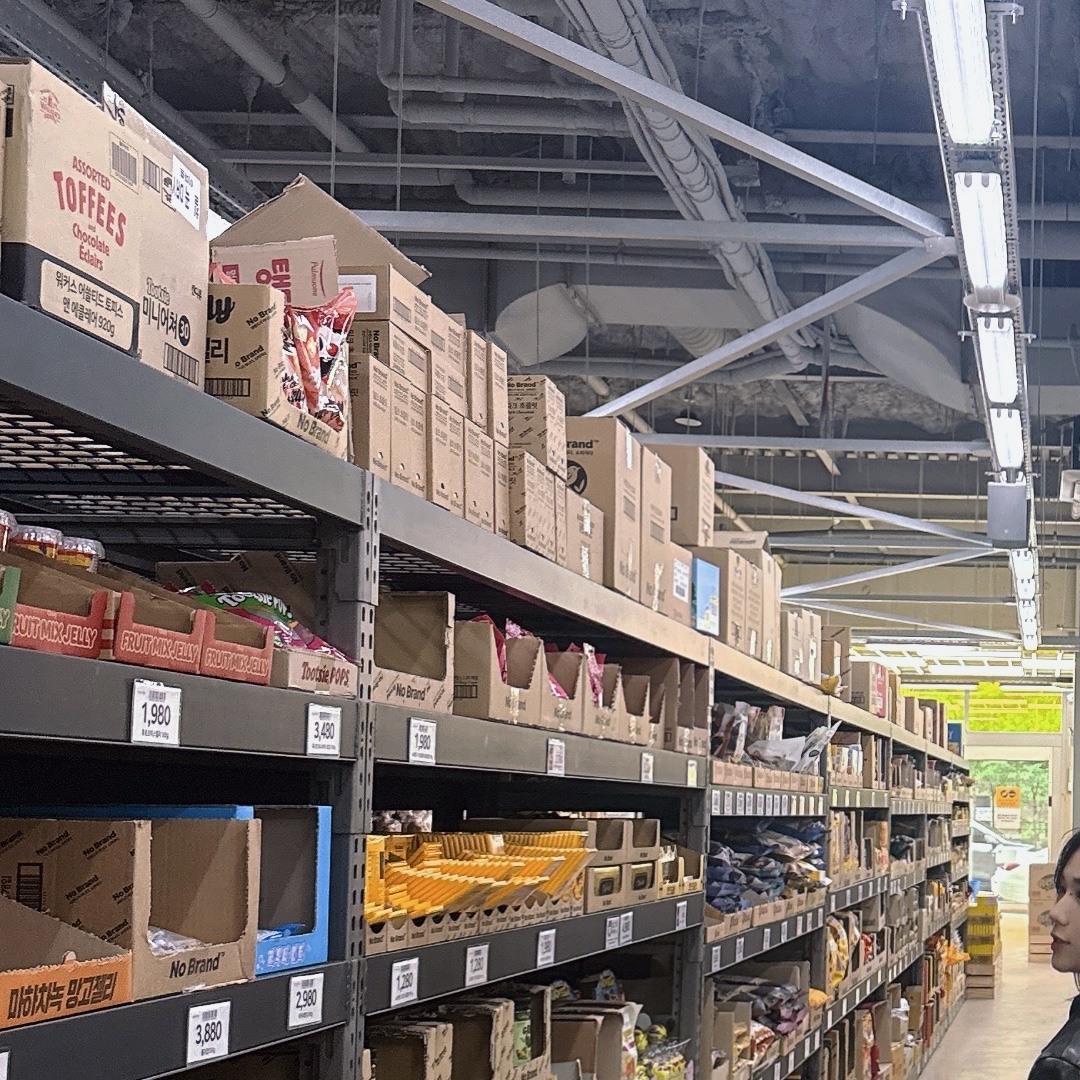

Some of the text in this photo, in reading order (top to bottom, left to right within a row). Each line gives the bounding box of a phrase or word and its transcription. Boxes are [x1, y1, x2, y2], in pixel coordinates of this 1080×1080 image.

[73, 156, 111, 191] ASSORTED
[53, 171, 127, 247] TOFFEES
[72, 223, 110, 256] Chocolate
[79, 242, 104, 271] Éclairs
[55, 271, 77, 293] 워커스
[310, 261, 319, 298] Pulmuone
[98, 316, 116, 337] 920g
[143, 296, 178, 340] 미니어쳐
[246, 316, 258, 327] No
[241, 345, 265, 364] Brand
[297, 413, 332, 445] No Brand
[41, 617, 64, 644] MIX
[63, 624, 98, 650] JELLY
[121, 629, 199, 663] FRUIT MIX JELLY
[204, 647, 270, 678] FRUIT MIX JELLY
[301, 661, 350, 688] Tootsie POPS
[395, 682, 427, 701] No Brand
[141, 702, 171, 727] 1,980
[314, 721, 335, 742] 3,480
[414, 733, 431, 750] 1,980
[35, 830, 71, 856] No Brand
[83, 830, 117, 857] No Brand
[65, 874, 99, 901] No Brand
[106, 919, 129, 937] Brand
[169, 960, 186, 979] No
[66, 972, 119, 1010] 망고젤리
[295, 989, 317, 1011] 2,980
[195, 1020, 222, 1047] 3,880
